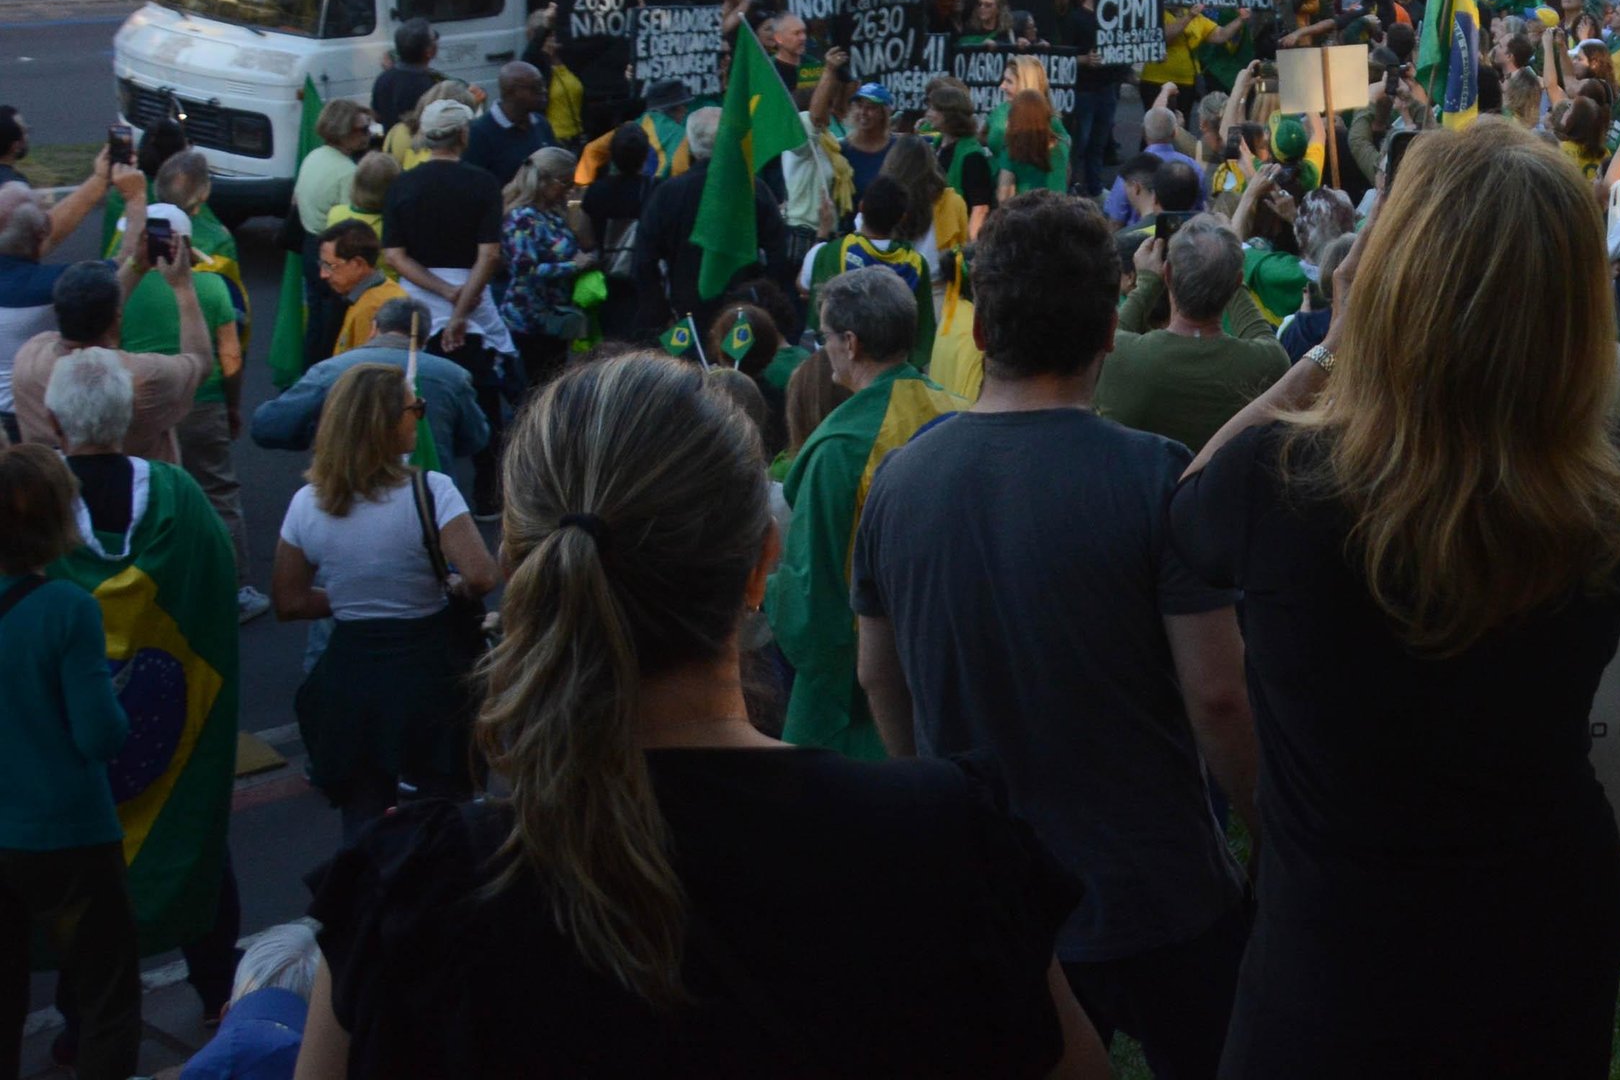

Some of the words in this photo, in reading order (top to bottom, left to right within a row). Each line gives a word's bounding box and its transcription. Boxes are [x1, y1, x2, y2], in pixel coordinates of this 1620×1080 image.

[570, 9, 632, 39] NÃO!
[852, 5, 904, 41] 2630
[636, 34, 649, 57] E
[850, 27, 916, 79] NÃO!
[966, 52, 1003, 81] AGRO
